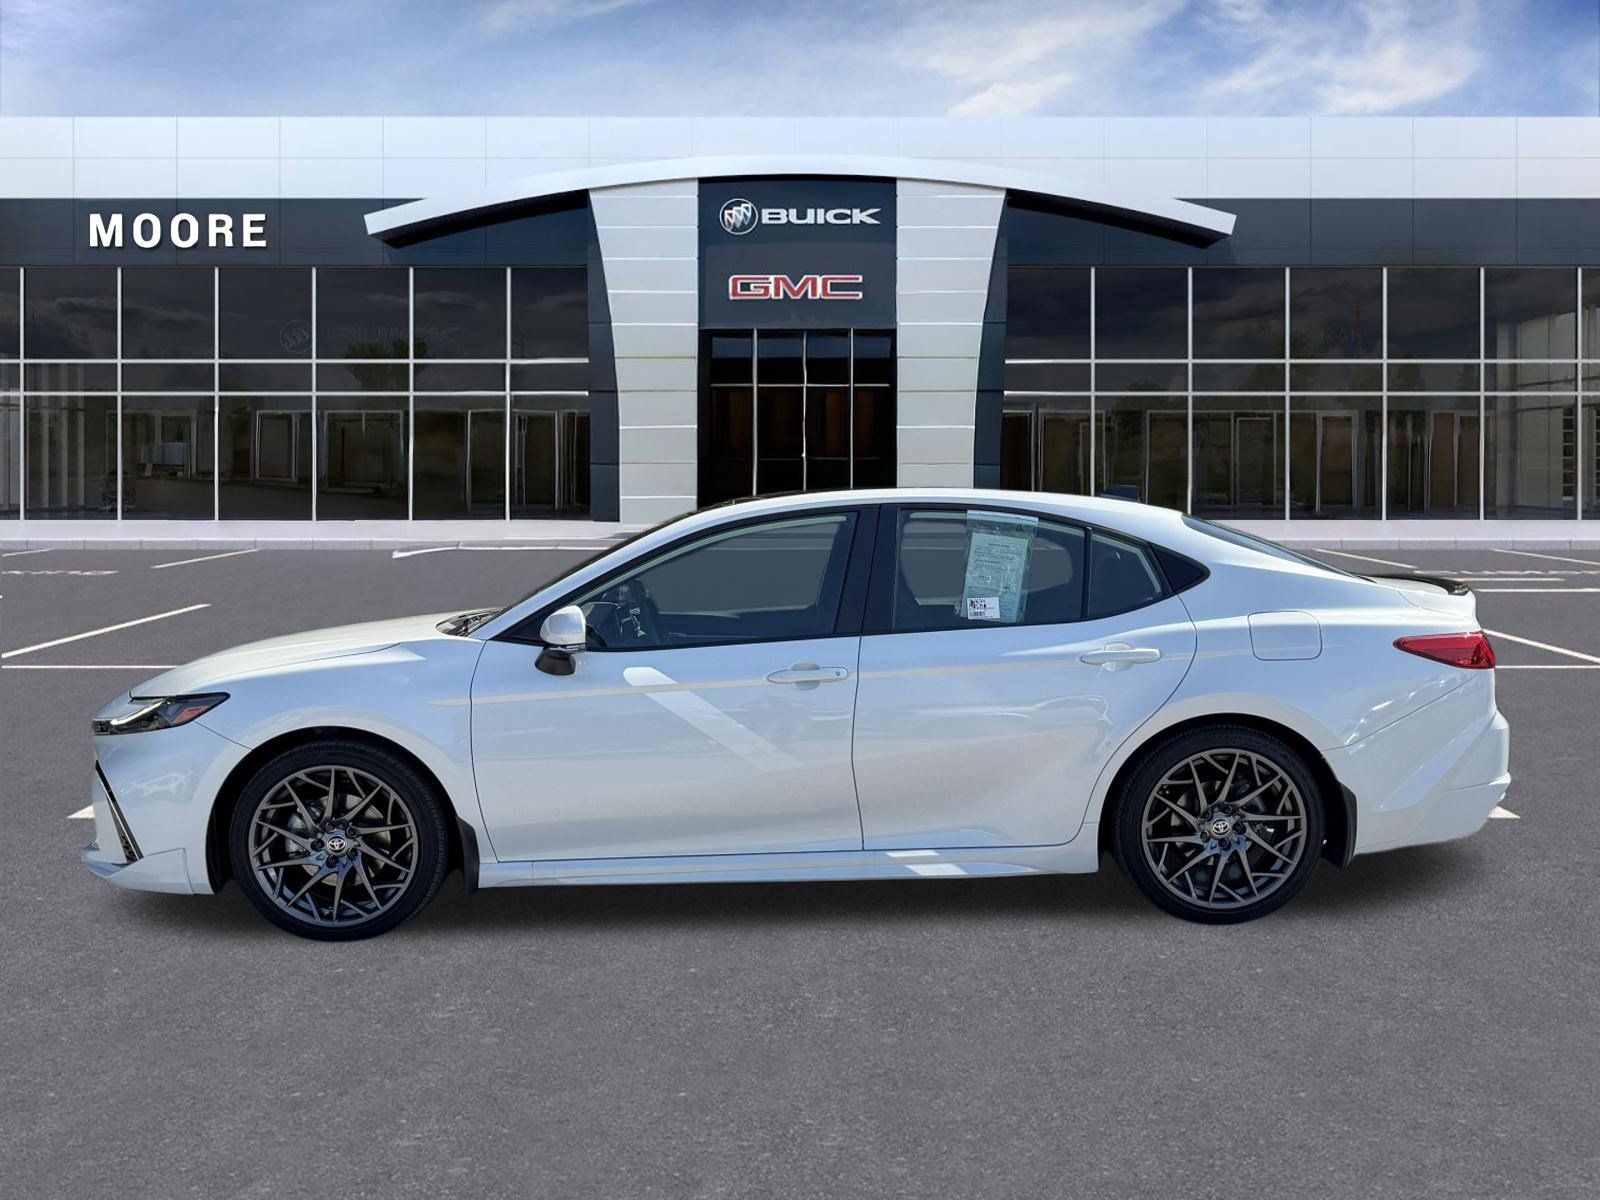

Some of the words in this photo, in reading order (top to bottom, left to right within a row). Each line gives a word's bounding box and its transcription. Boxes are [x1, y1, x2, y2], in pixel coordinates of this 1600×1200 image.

[761, 208, 882, 225] BUICK
[89, 213, 267, 248] MOORE
[728, 274, 863, 301] GMC
